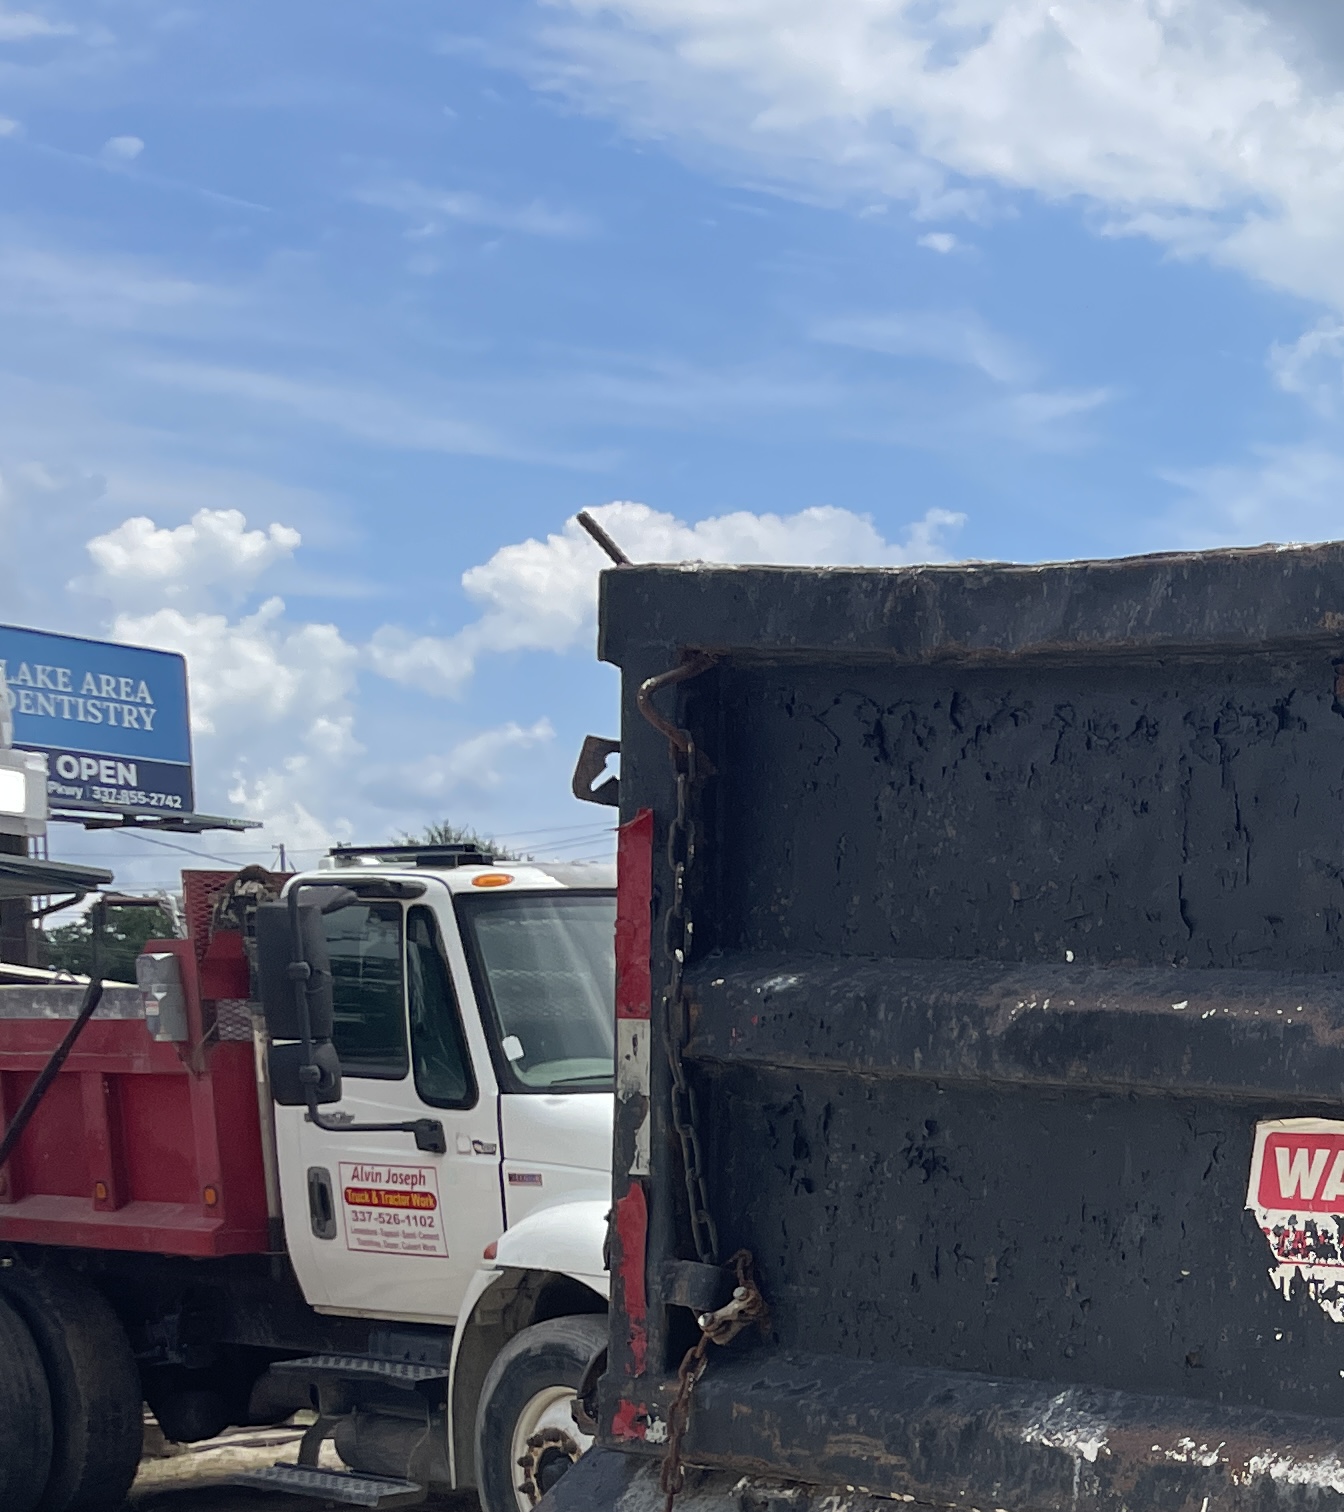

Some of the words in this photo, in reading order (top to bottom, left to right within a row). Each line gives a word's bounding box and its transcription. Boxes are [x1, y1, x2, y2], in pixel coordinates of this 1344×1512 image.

[81, 671, 154, 704] AREA
[55, 754, 138, 787] OPEN
[92, 786, 182, 809] 337-855-2742
[351, 1166, 382, 1184] Alvin
[385, 1168, 426, 1191] Joseph
[346, 1189, 371, 1204] Truck
[410, 1193, 435, 1208] Work
[351, 1209, 435, 1228] 337-526-1102
